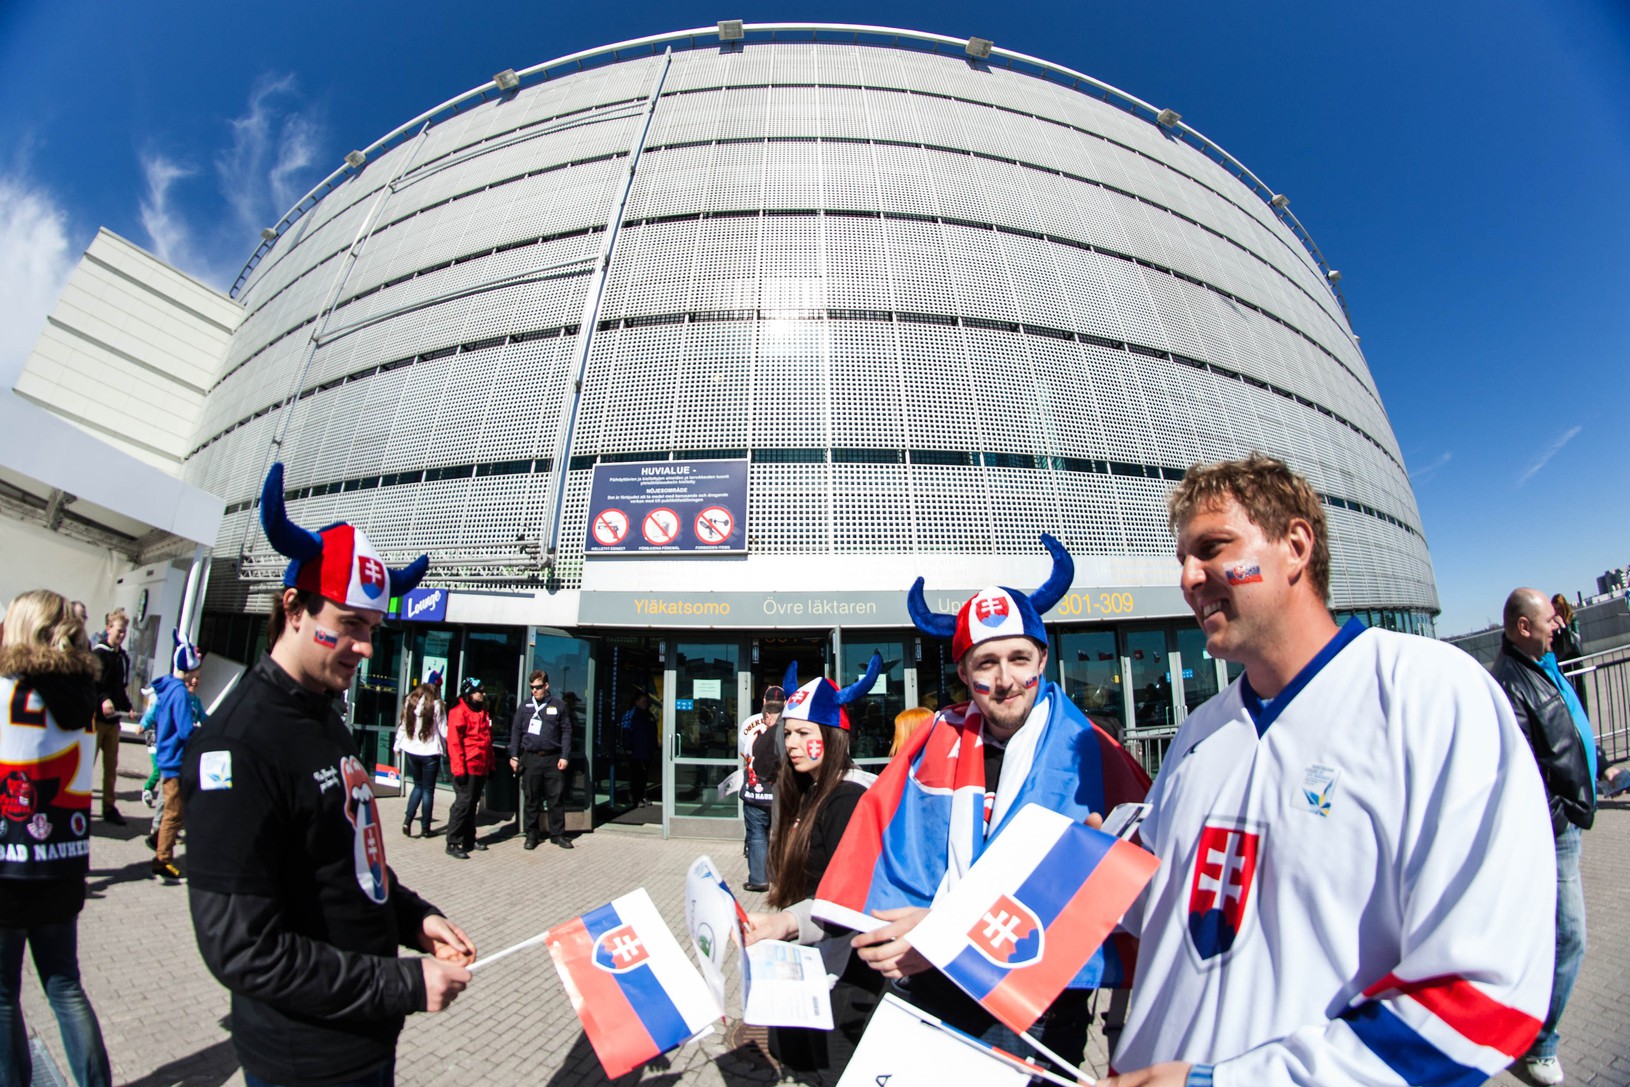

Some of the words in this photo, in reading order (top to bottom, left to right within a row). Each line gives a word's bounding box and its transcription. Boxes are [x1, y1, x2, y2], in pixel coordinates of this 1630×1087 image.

[641, 466, 690, 475] HUVIALUE
[408, 590, 441, 618] Lounge
[634, 599, 731, 615] Yläkatsomo
[763, 596, 803, 615] Övre
[808, 599, 876, 615] läktaren
[1058, 592, 1134, 616] 301-309
